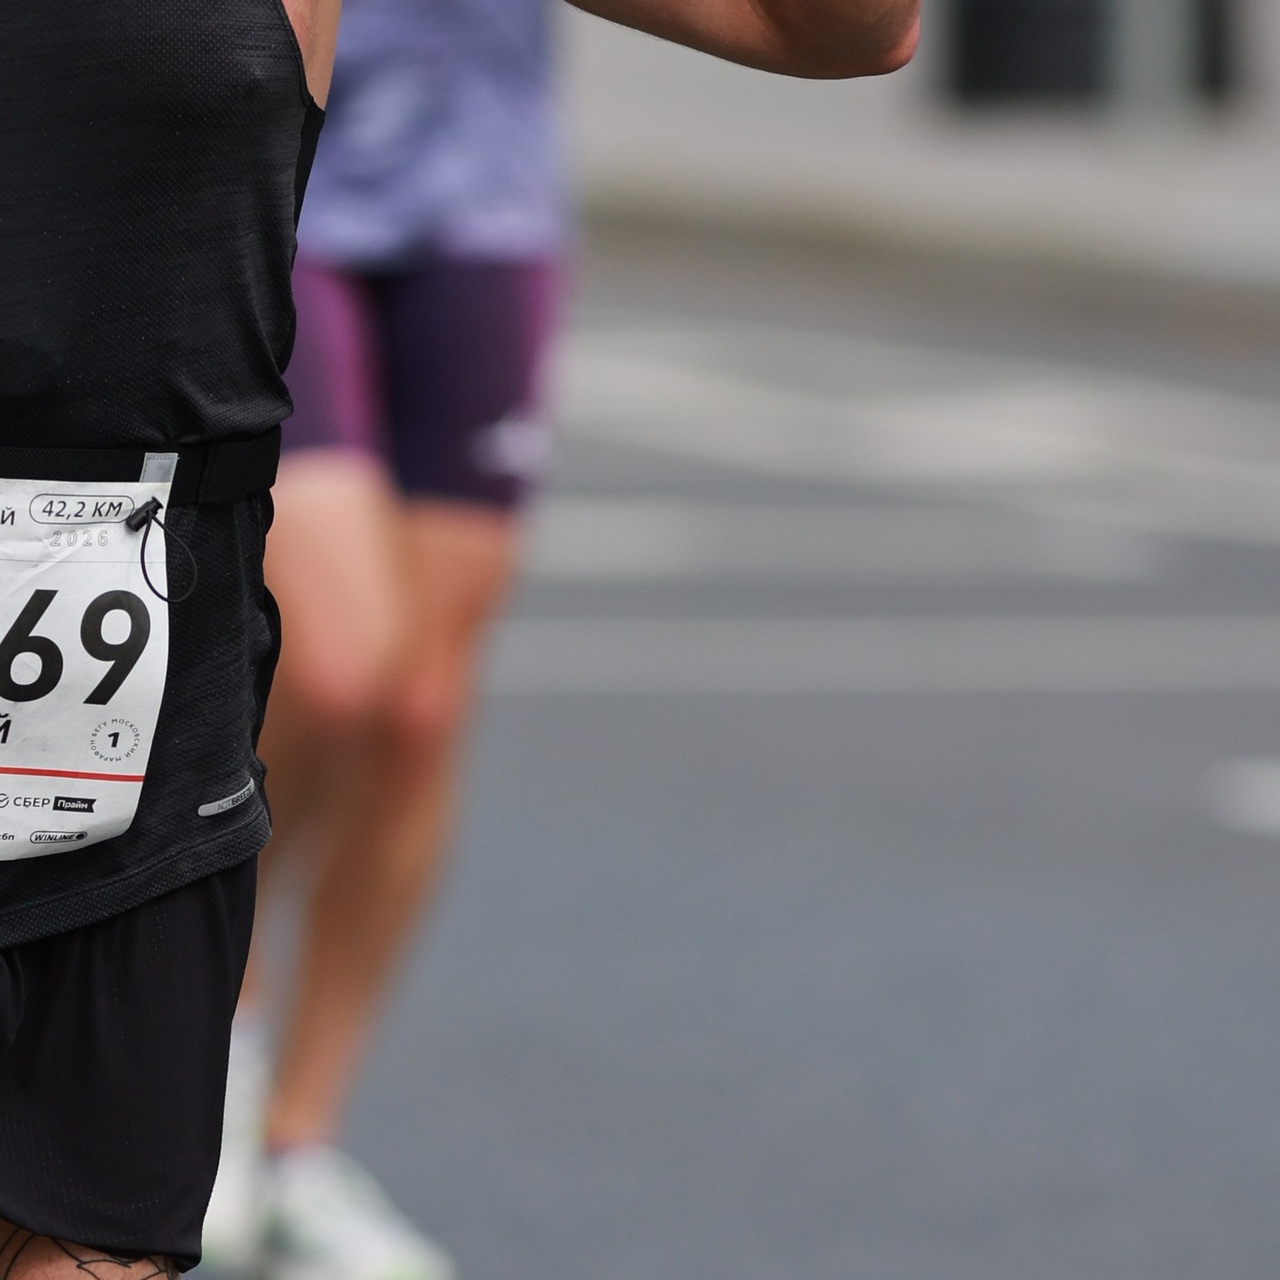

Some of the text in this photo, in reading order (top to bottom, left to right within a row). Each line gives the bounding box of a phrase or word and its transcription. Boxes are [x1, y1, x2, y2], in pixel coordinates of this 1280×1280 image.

[42, 500, 123, 520] 42,2 КМ
[50, 530, 108, 547] 2026
[108, 731, 120, 748] 1
[13, 796, 88, 810] СБЕР Прайм
